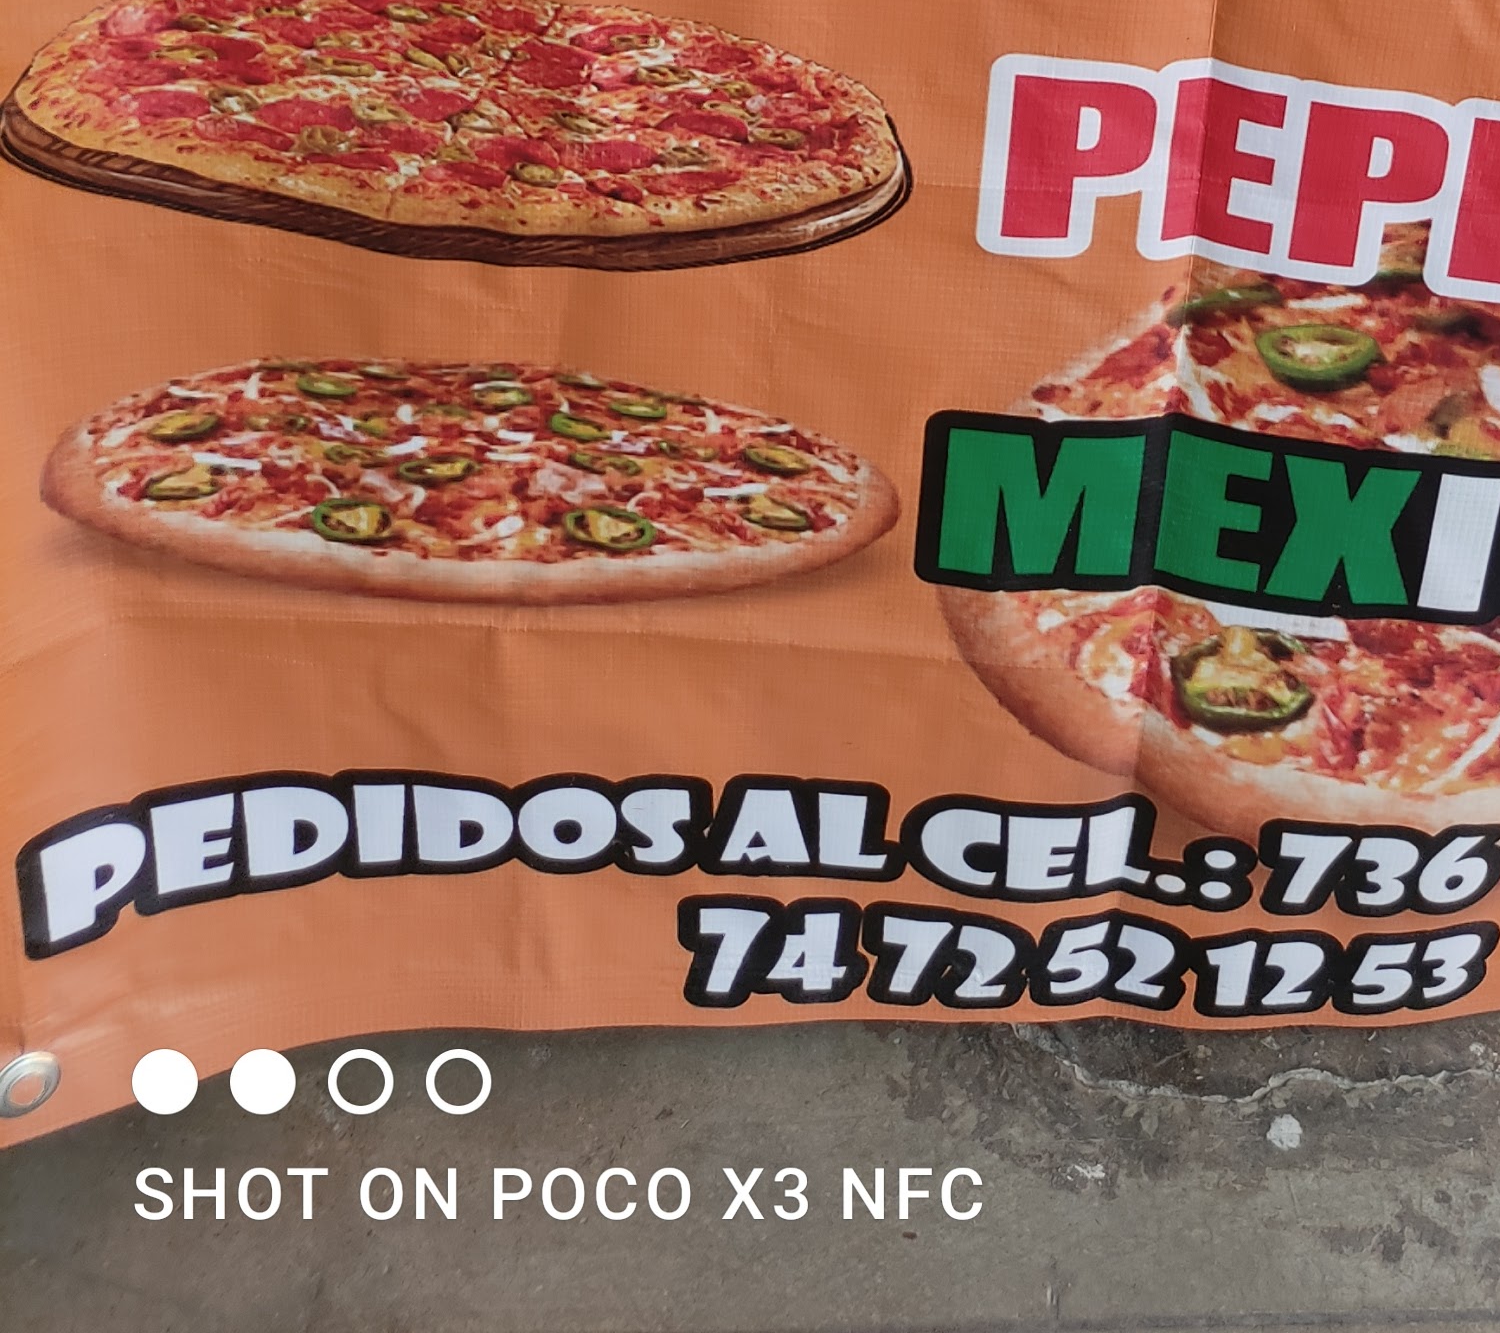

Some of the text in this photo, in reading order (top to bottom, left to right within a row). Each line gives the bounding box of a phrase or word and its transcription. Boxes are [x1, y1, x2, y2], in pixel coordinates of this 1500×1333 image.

[37, 782, 692, 947] PEDIDOS
[718, 787, 887, 871] AL
[1277, 831, 1493, 910] 736
[1350, 933, 1484, 1006] 53
